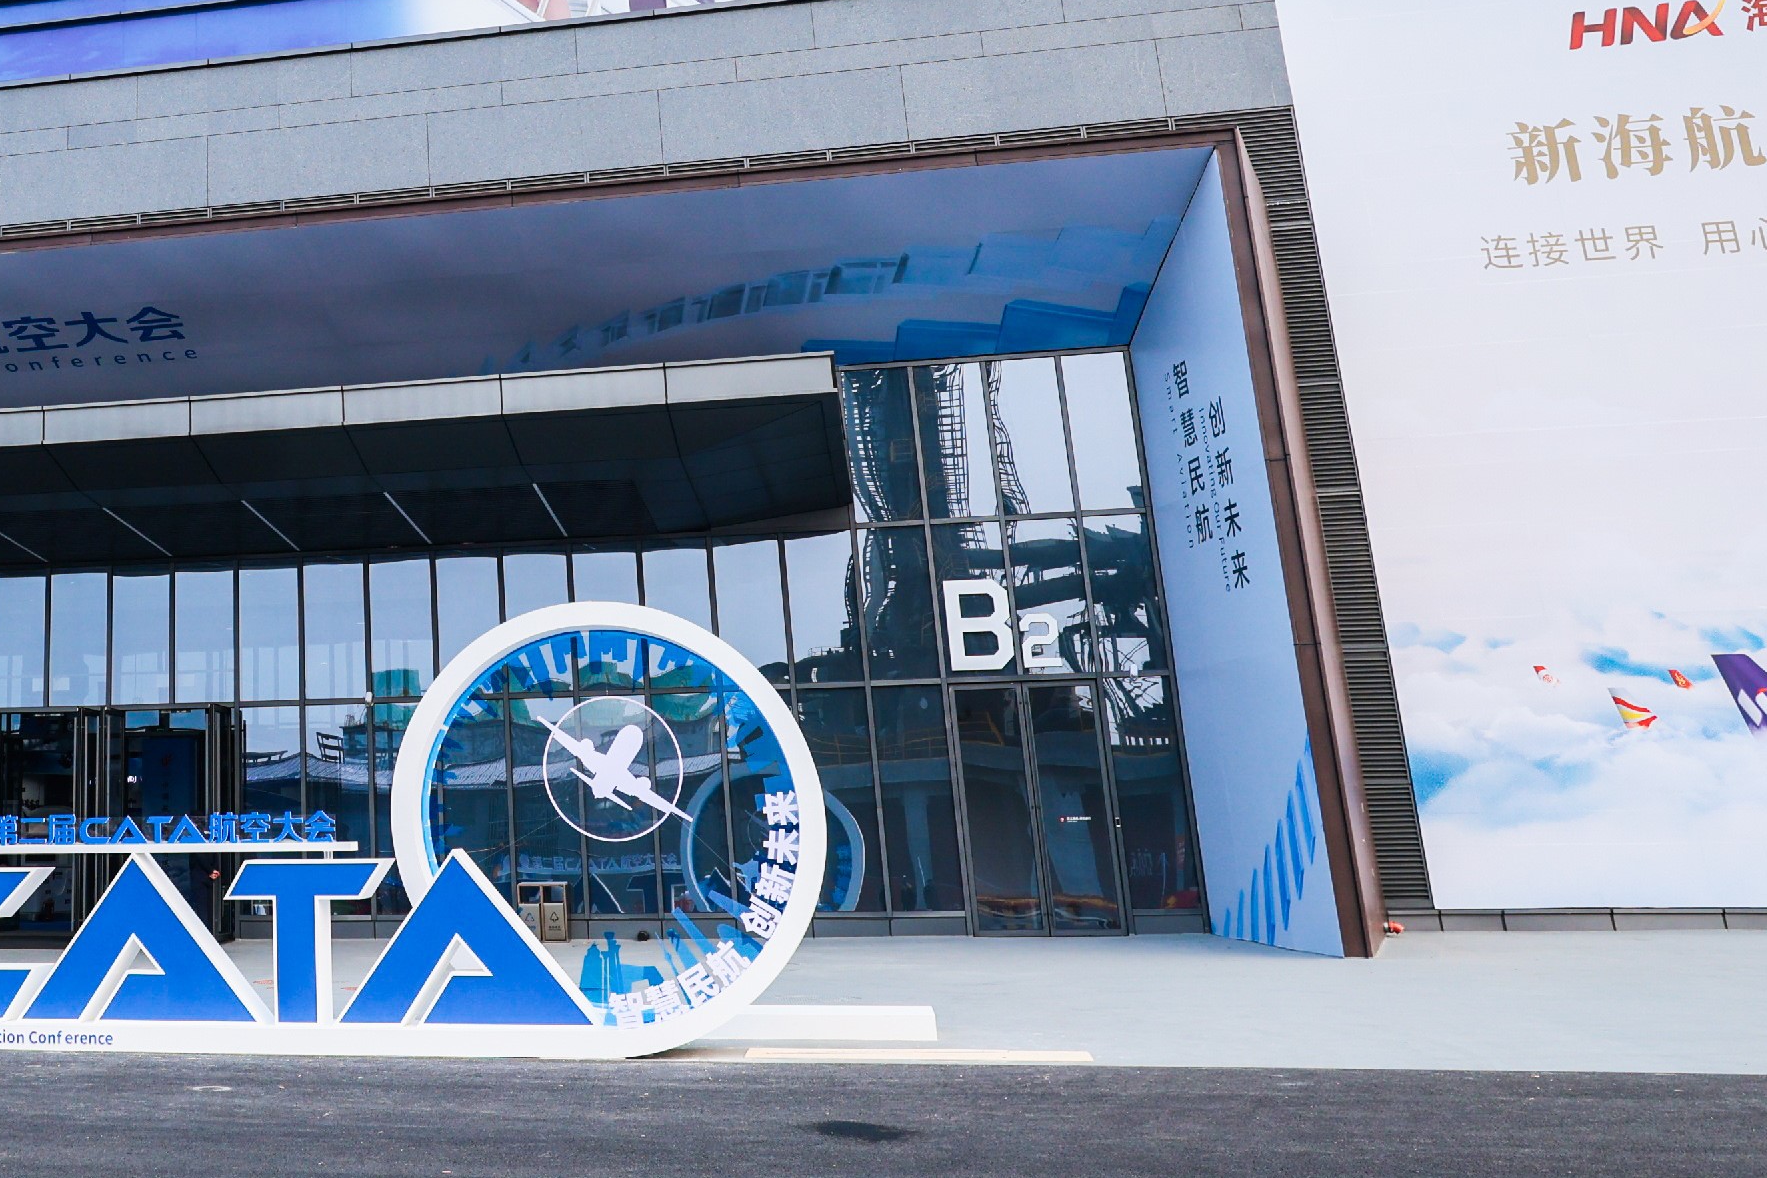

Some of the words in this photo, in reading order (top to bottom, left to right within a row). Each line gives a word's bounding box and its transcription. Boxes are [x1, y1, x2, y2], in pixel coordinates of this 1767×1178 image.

[1505, 105, 1767, 185] 新海航
[1480, 225, 1664, 270] 连接世界
[1172, 360, 1213, 544] 智慧民航
[1208, 396, 1250, 589] 创新未来
[943, 579, 1063, 671] B2
[740, 789, 800, 940] 创新未来
[608, 940, 752, 1030] 智慧民航
